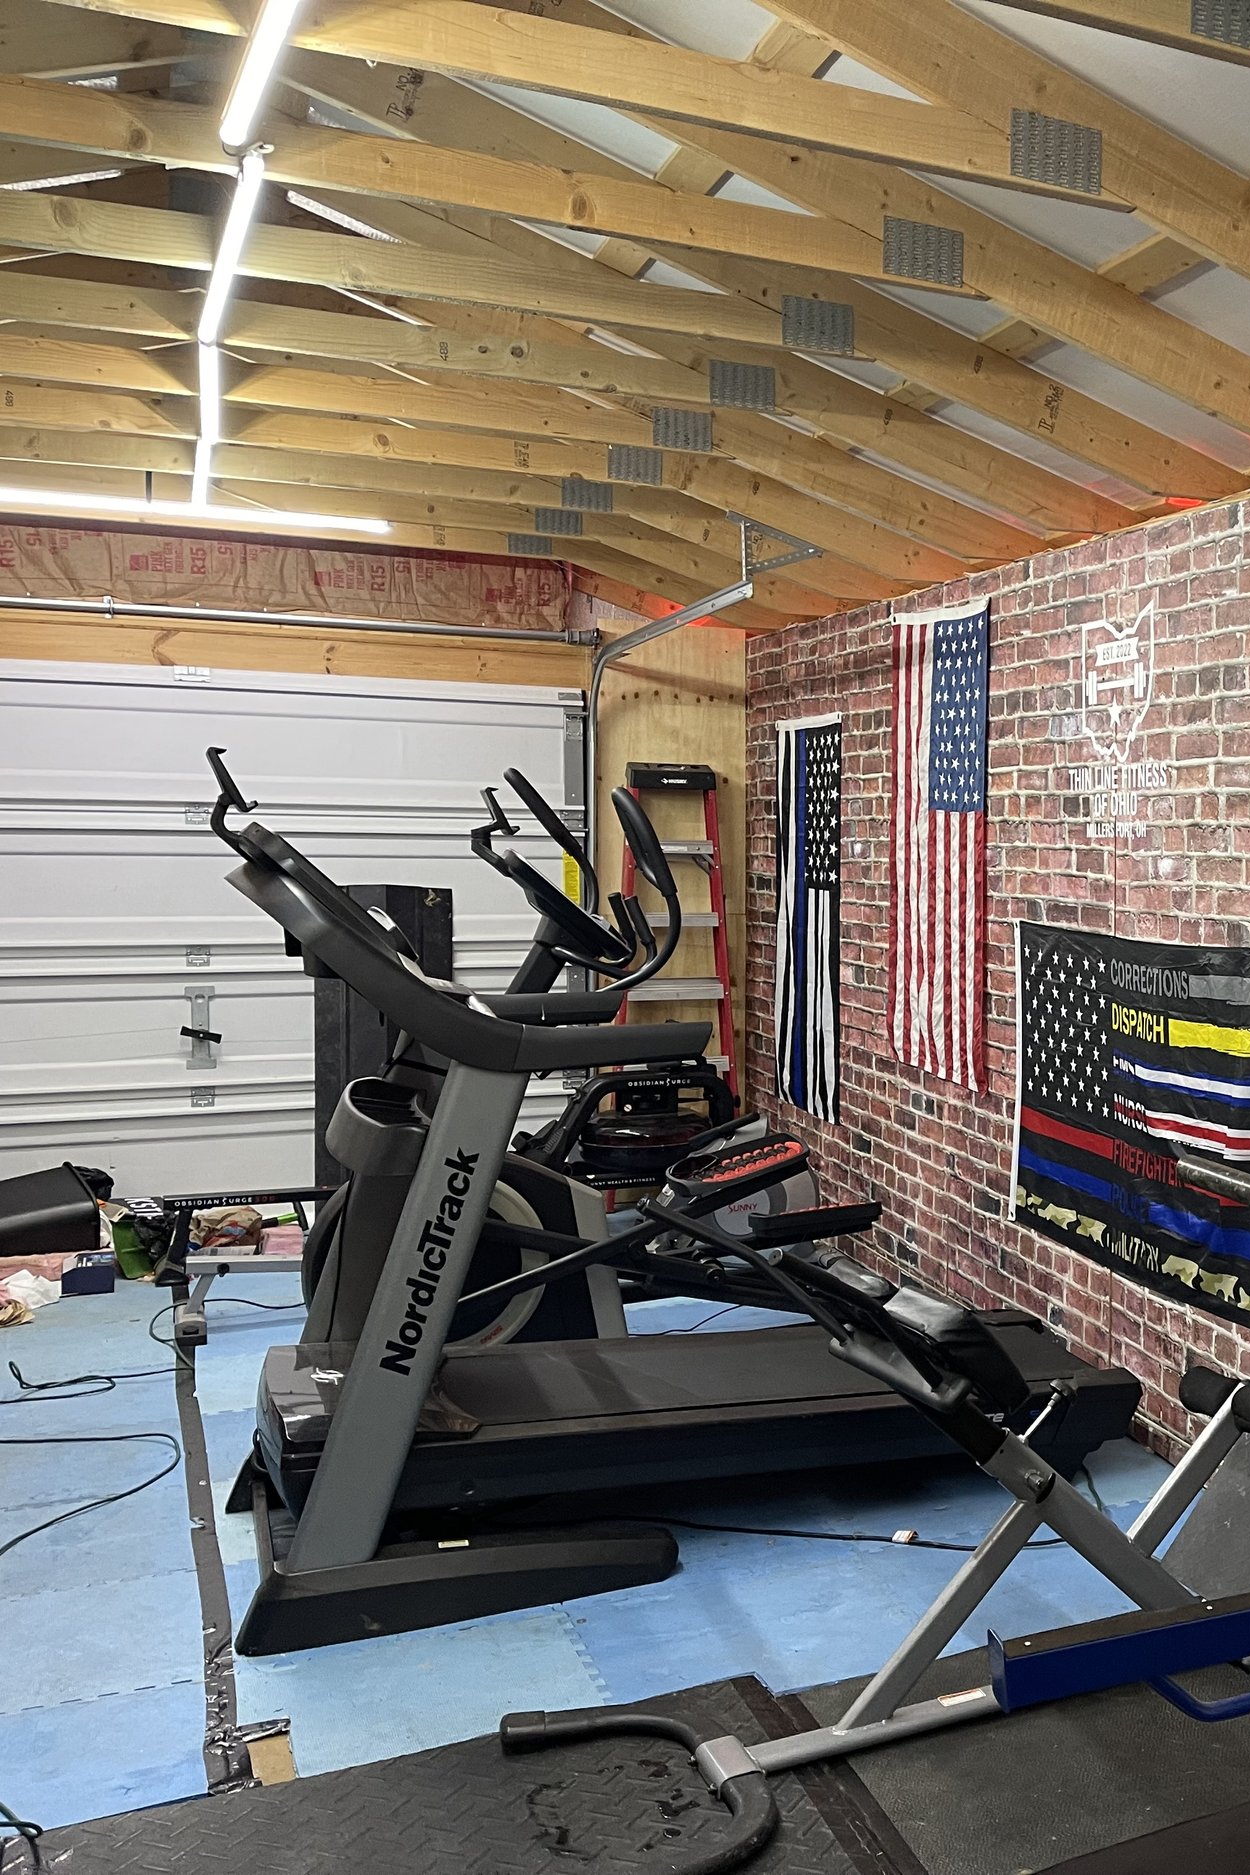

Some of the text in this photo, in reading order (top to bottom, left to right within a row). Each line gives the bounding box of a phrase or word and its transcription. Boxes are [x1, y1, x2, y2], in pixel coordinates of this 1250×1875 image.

[189, 546, 207, 575] R15
[370, 564, 386, 592] R15
[1102, 643, 1132, 661] EST. 2022
[1068, 761, 1168, 791] THIN LINE FITNESS
[1094, 791, 1138, 818] OF OHIO
[1136, 820, 1147, 838] OH
[1110, 958, 1189, 999] CORRECTIONS
[1111, 1002, 1165, 1044] DISPATCH
[174, 1199, 220, 1207] OBSIDIAN
[727, 1202, 758, 1215] SUNNY
[379, 1146, 480, 1376] NordicTrack
